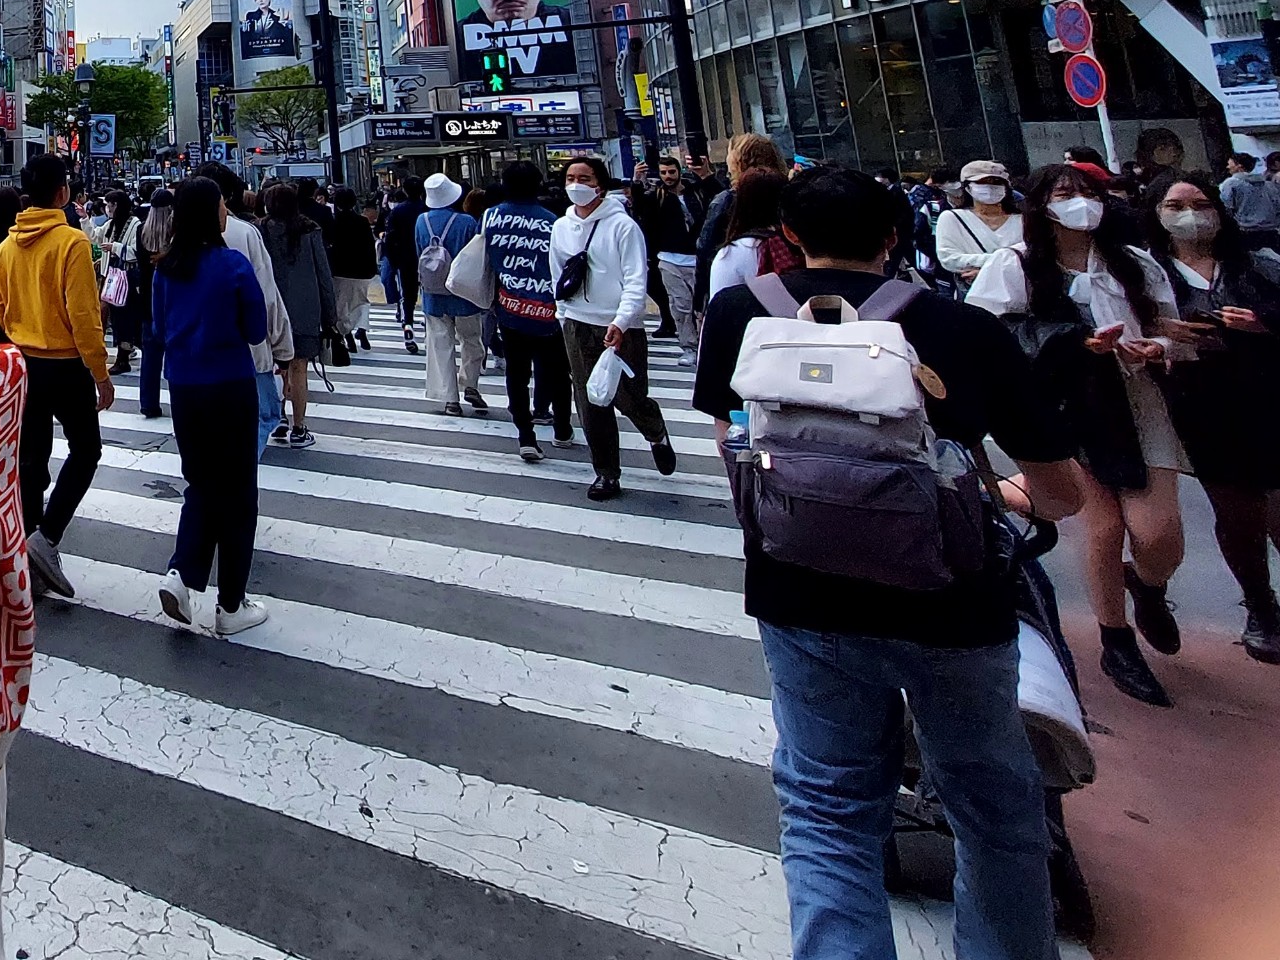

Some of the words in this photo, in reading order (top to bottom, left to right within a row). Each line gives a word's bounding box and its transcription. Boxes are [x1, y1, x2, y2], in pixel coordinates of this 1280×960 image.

[463, 15, 568, 50] DMM
[463, 120, 502, 130] しぶちか
[490, 234, 549, 253] DEPENDS
[503, 254, 538, 272] UPON
[499, 272, 555, 294] RSELVES
[520, 303, 554, 318] LEGEND
